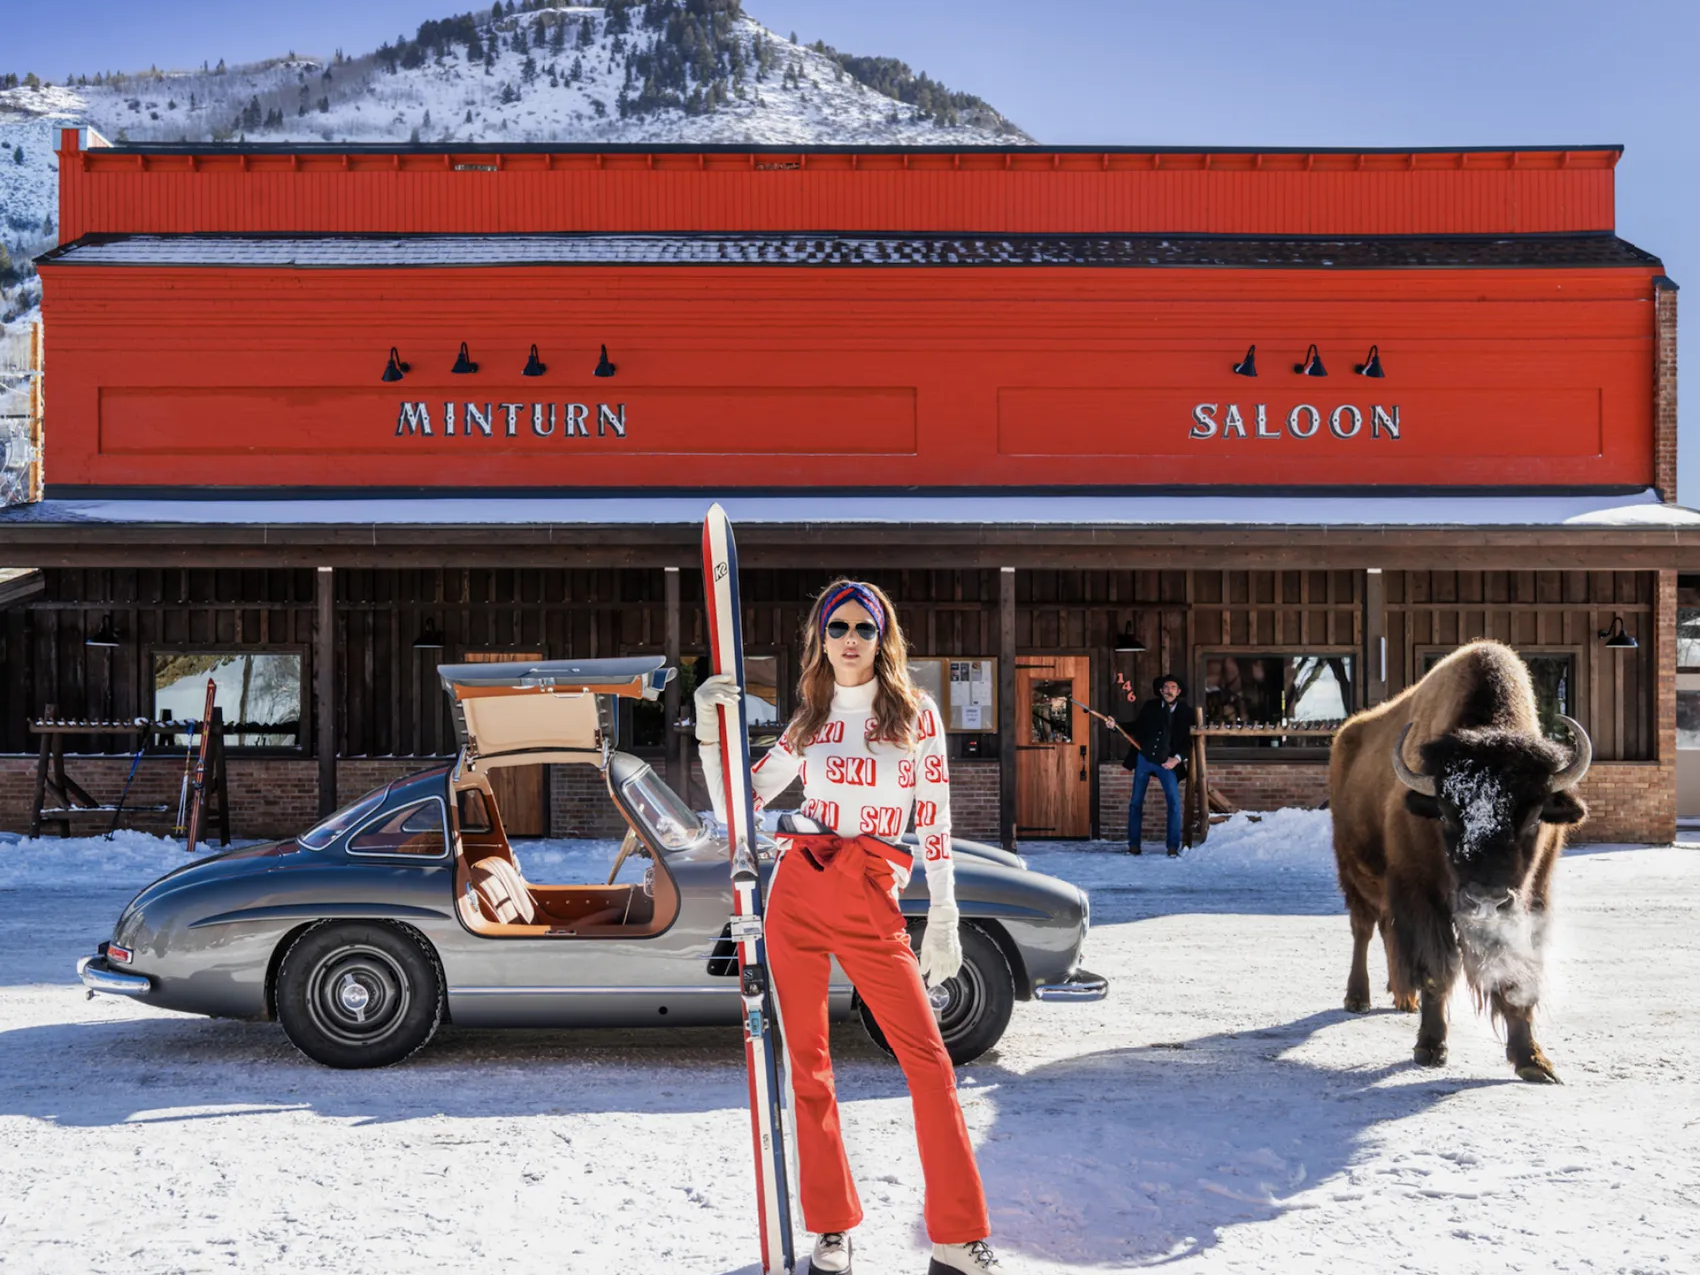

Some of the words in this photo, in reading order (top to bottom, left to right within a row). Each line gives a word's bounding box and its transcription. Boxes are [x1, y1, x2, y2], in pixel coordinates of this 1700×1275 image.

[394, 401, 627, 438] MINTURN
[1189, 402, 1401, 440] SALOON
[713, 561, 728, 582] K2
[1116, 672, 1136, 702] 146
[826, 755, 876, 787] SKI
[860, 805, 903, 838] SKI
